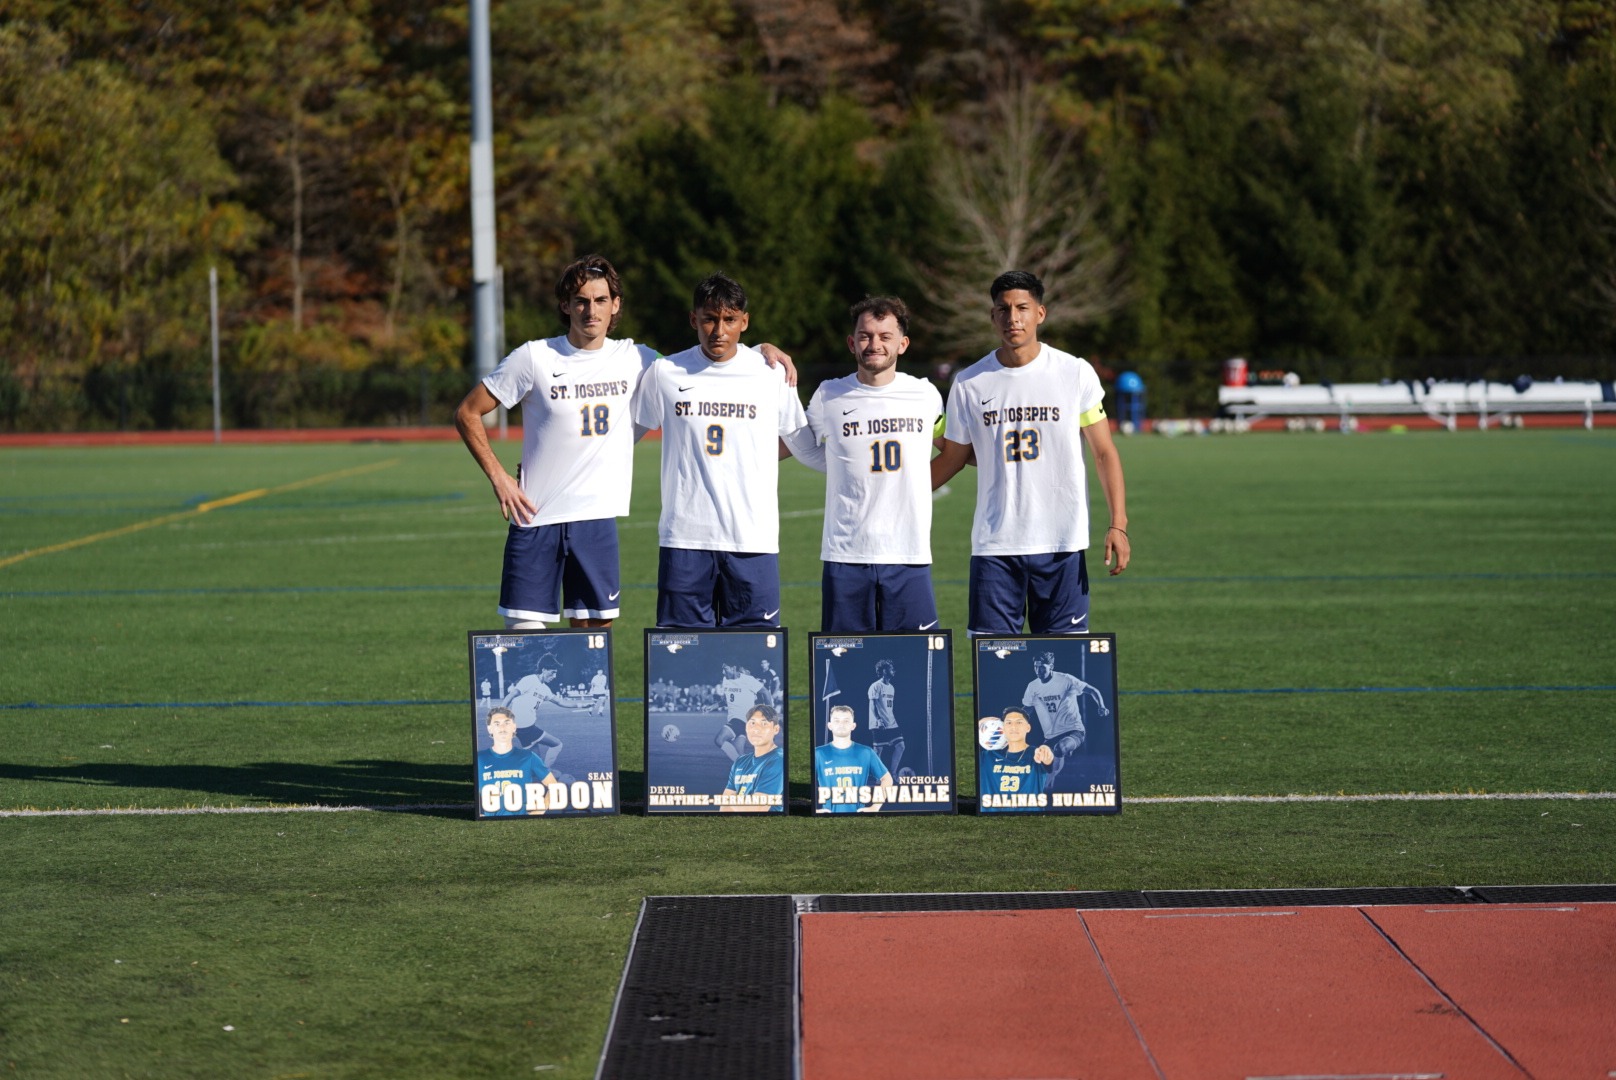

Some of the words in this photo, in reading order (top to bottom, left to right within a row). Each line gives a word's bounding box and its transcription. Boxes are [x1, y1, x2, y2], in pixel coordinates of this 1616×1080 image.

[550, 385, 570, 400] ST.
[574, 380, 628, 399] JOSEPH'S
[675, 401, 693, 417] ST.
[698, 401, 757, 419] JOSEPH'S
[983, 410, 1002, 427] ST.
[1003, 406, 1060, 423] JOSEPH'S
[580, 403, 609, 436] 18
[843, 421, 863, 437] ST.
[867, 417, 924, 434] JOSEPH'S
[706, 424, 724, 456] 9
[1004, 428, 1039, 462] 23
[870, 439, 902, 473] 10
[587, 635, 605, 649] 18
[766, 635, 777, 648] 9
[928, 637, 944, 650] 10
[1090, 640, 1110, 653] 23
[588, 772, 613, 781] SEAN
[899, 776, 949, 784] NICHOLAS
[1000, 775, 1020, 792] 23
[481, 781, 613, 812] GORDON
[650, 785, 685, 794] DEYBIS
[818, 785, 950, 804] PENSAVALLE
[1090, 784, 1115, 793] SAUL
[649, 794, 783, 806] MARTINEZ-HERNANDEZ
[982, 793, 1048, 808] SALINAS
[1052, 793, 1116, 807] HUAMAN
